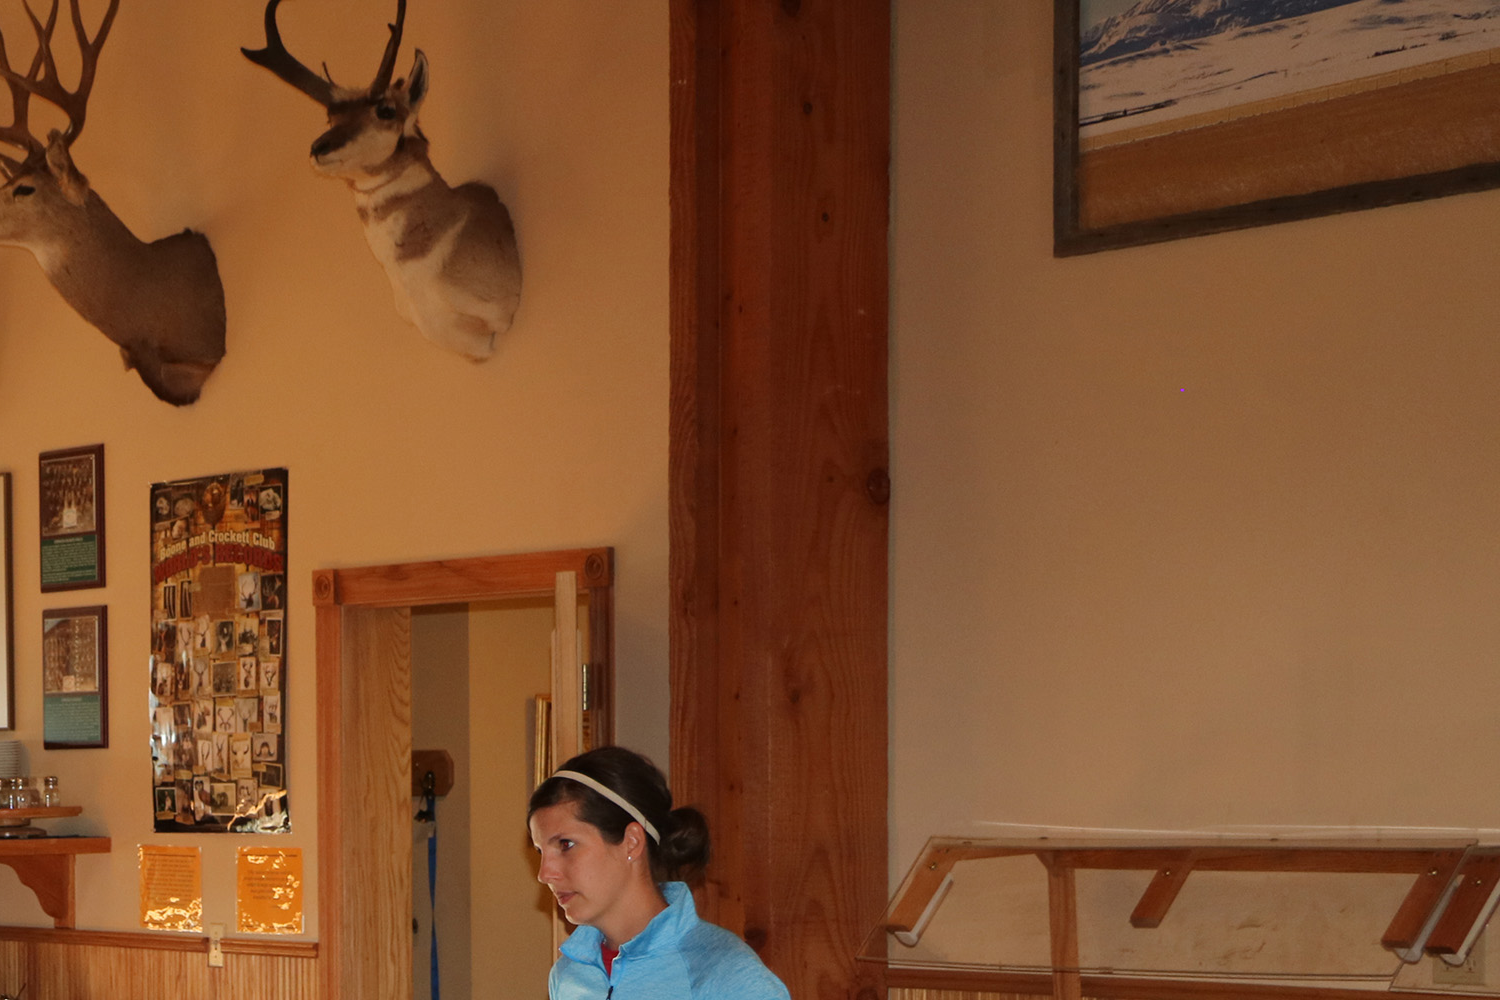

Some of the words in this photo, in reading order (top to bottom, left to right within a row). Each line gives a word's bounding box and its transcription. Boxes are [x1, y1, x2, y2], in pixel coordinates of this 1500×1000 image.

[160, 539, 187, 561] Boone
[189, 532, 206, 548] and
[208, 530, 250, 544] Crockett
[252, 532, 276, 550] Club
